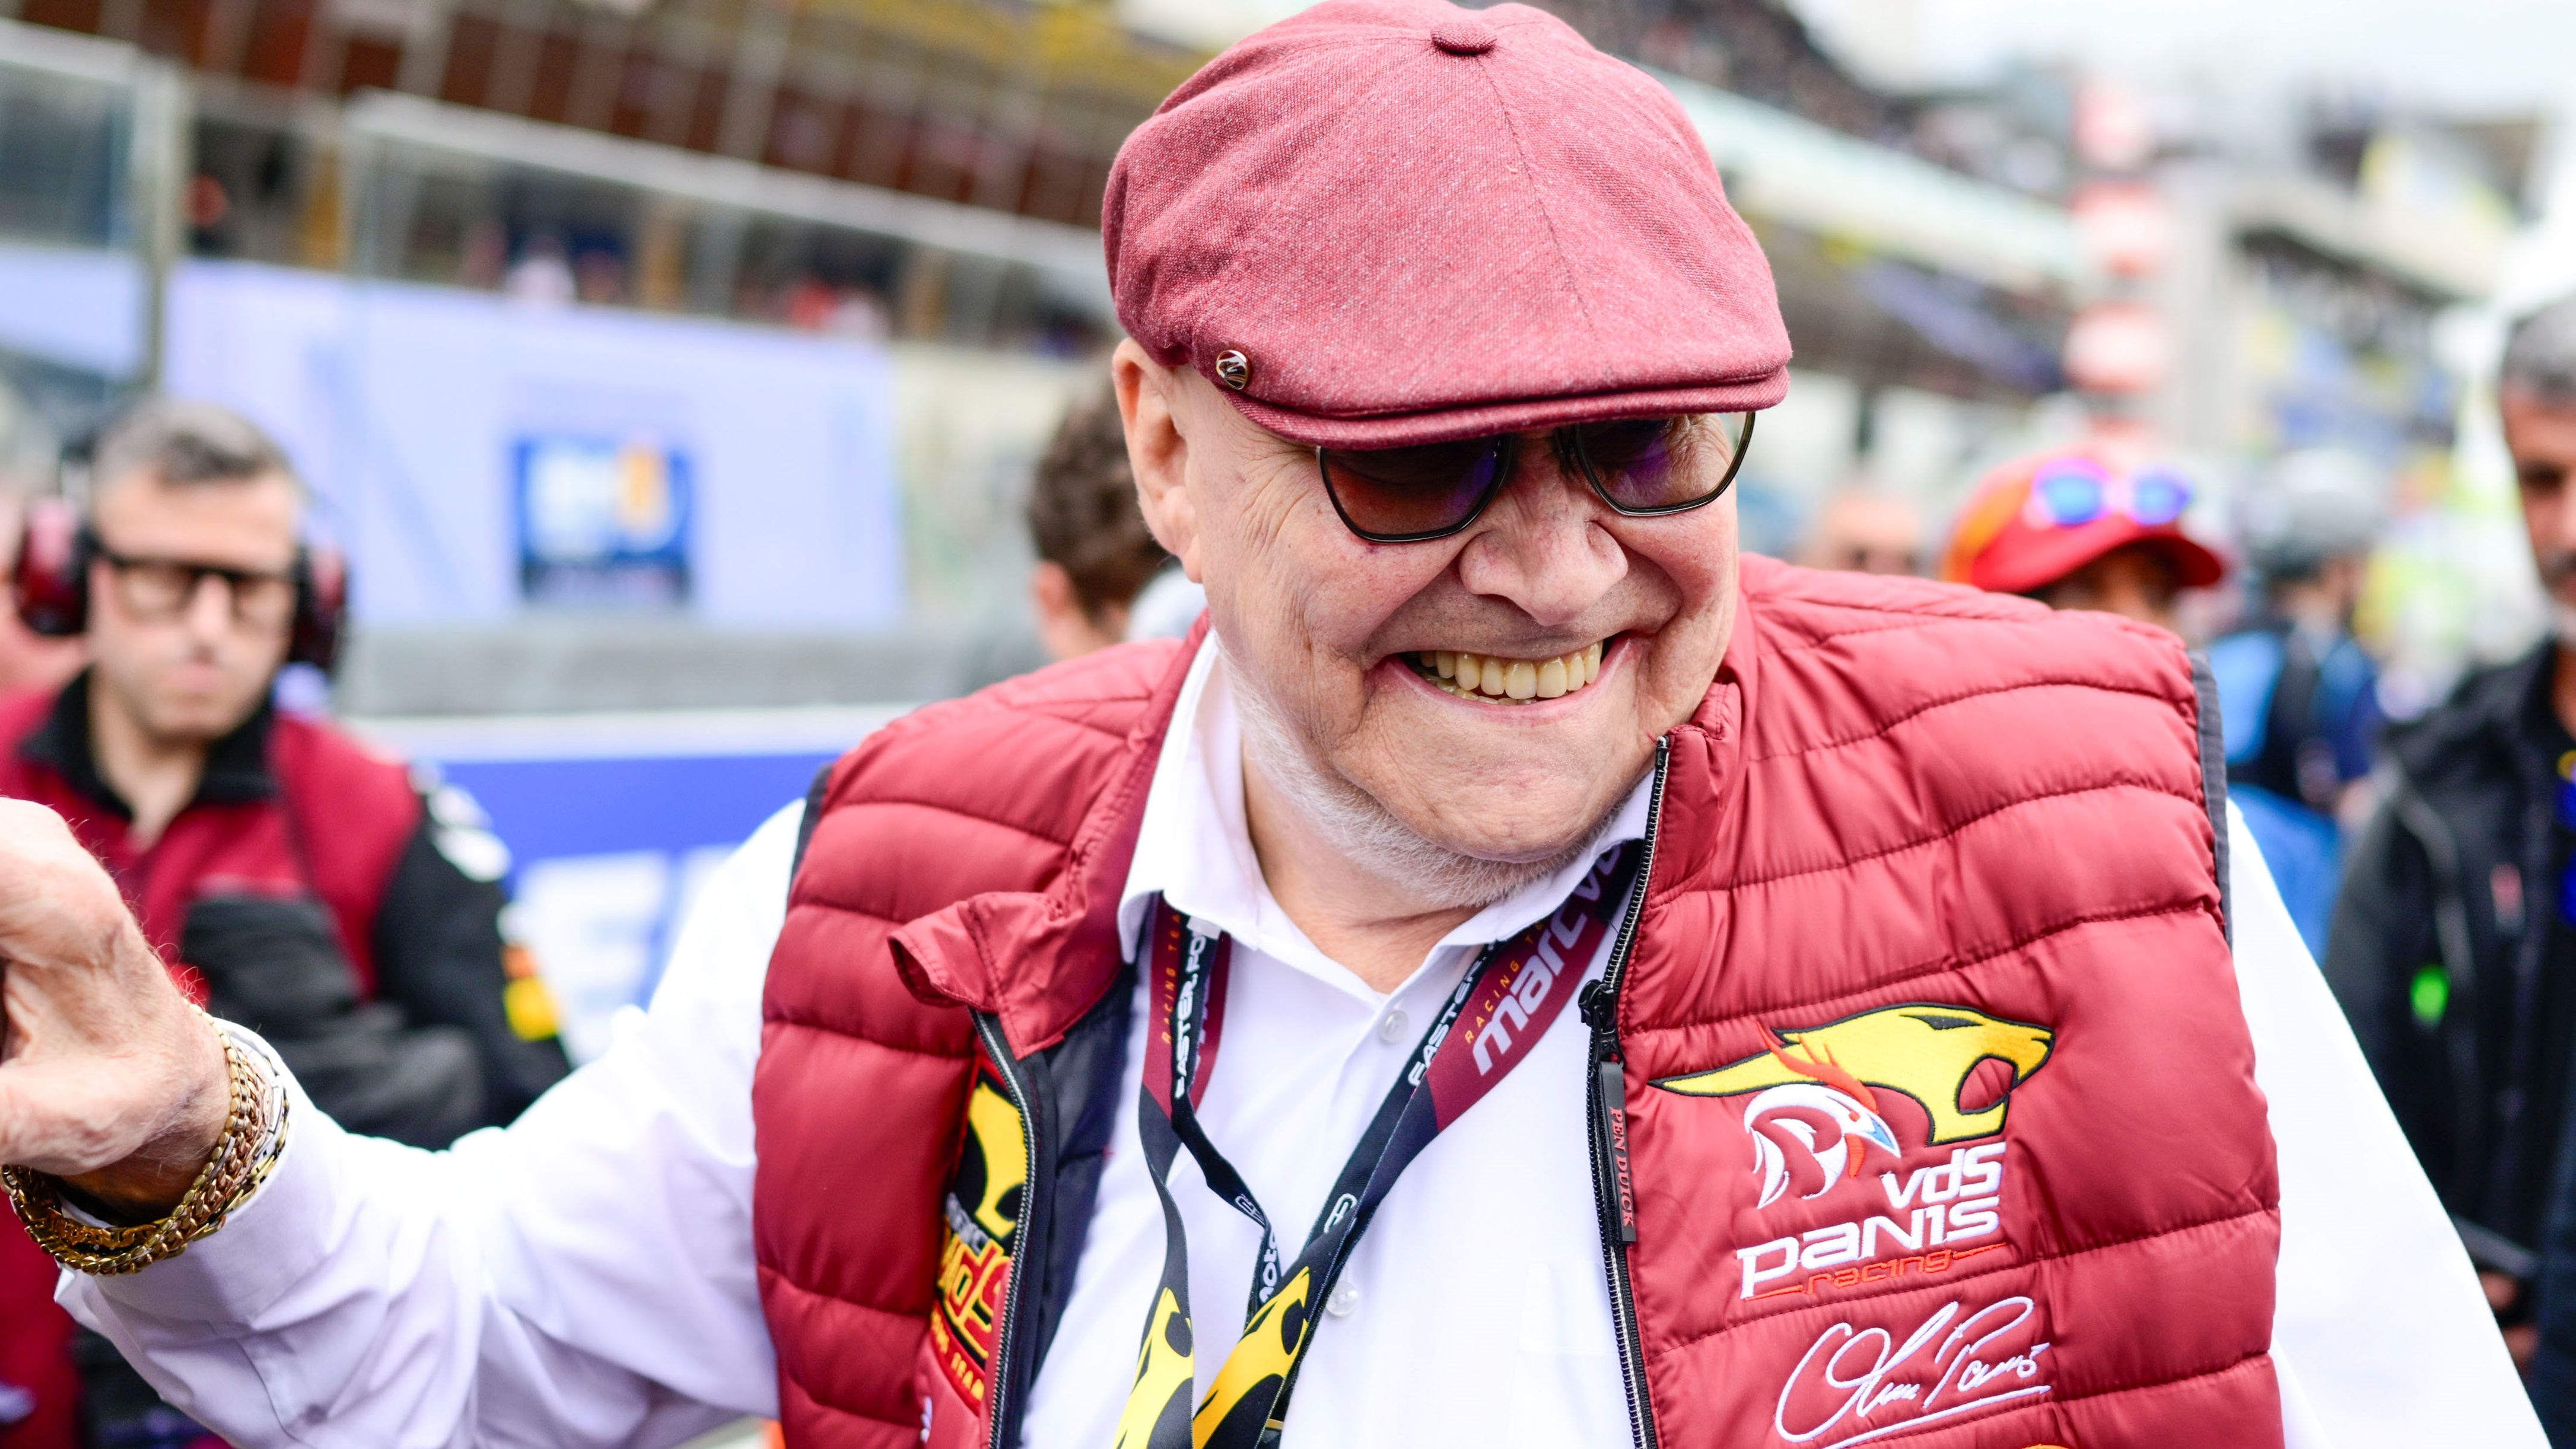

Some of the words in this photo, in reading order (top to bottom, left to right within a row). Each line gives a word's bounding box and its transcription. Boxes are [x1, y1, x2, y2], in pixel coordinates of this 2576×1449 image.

[1464, 960, 1520, 1044] RACING
[1609, 1107, 1626, 1151] PEN
[1615, 1155, 1635, 1228] DUICK
